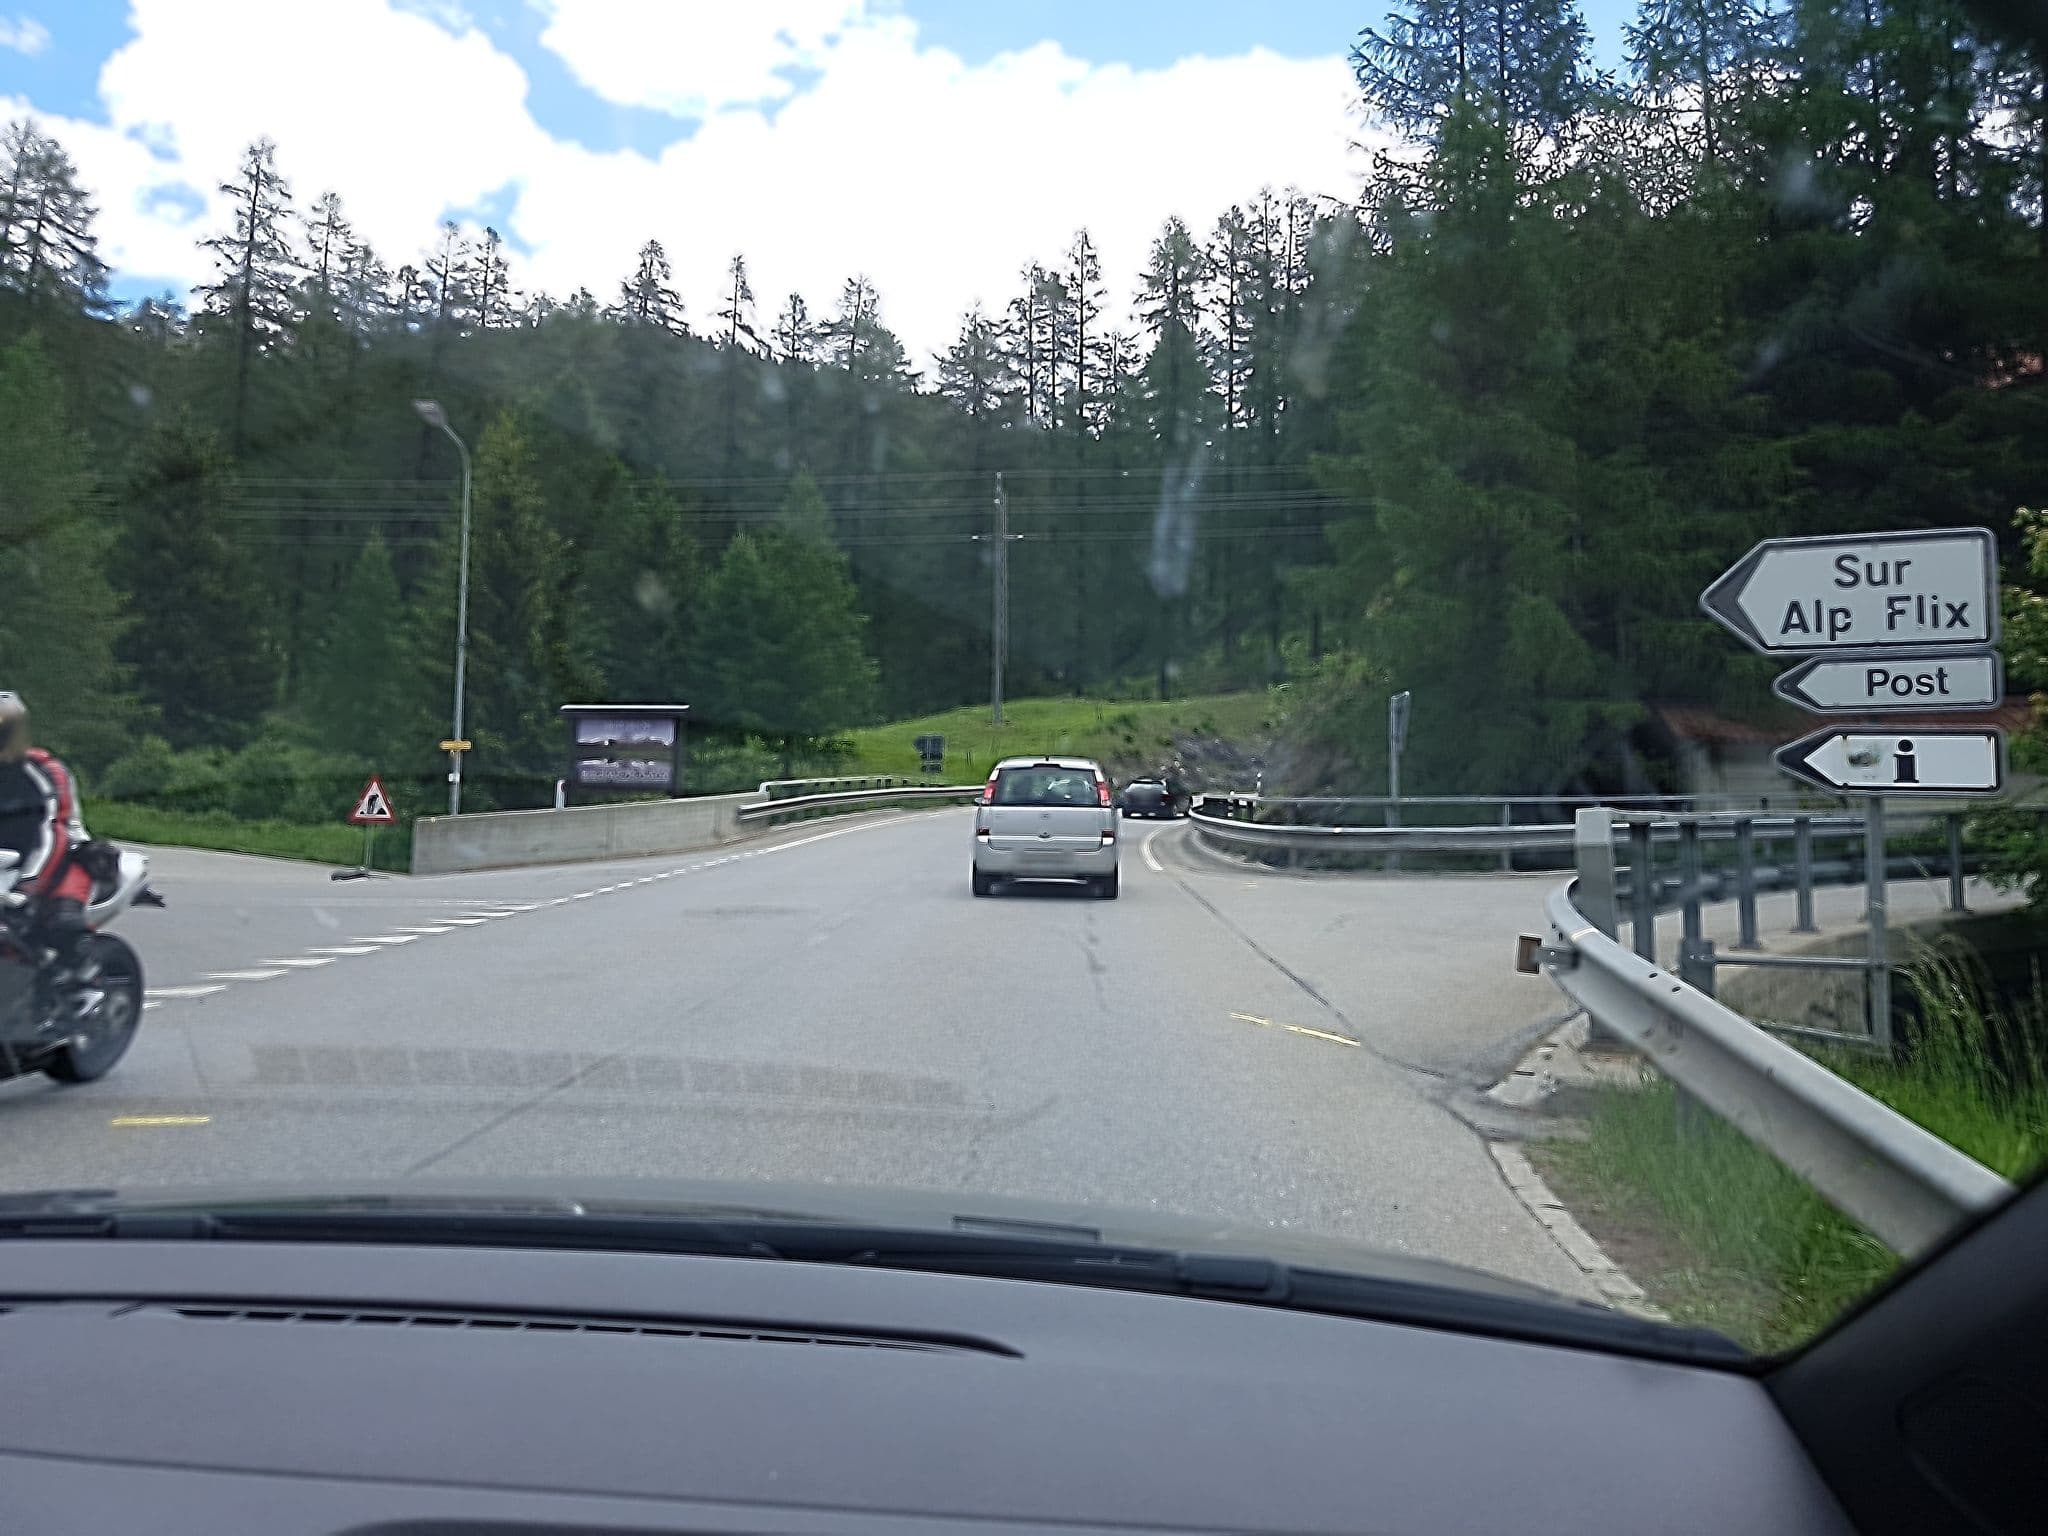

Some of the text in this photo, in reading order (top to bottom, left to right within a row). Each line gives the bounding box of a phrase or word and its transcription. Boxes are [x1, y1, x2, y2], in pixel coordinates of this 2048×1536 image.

[1834, 554, 1911, 588] Sur
[1781, 594, 1969, 641] Alp Flix
[1866, 667, 1950, 696] Post
